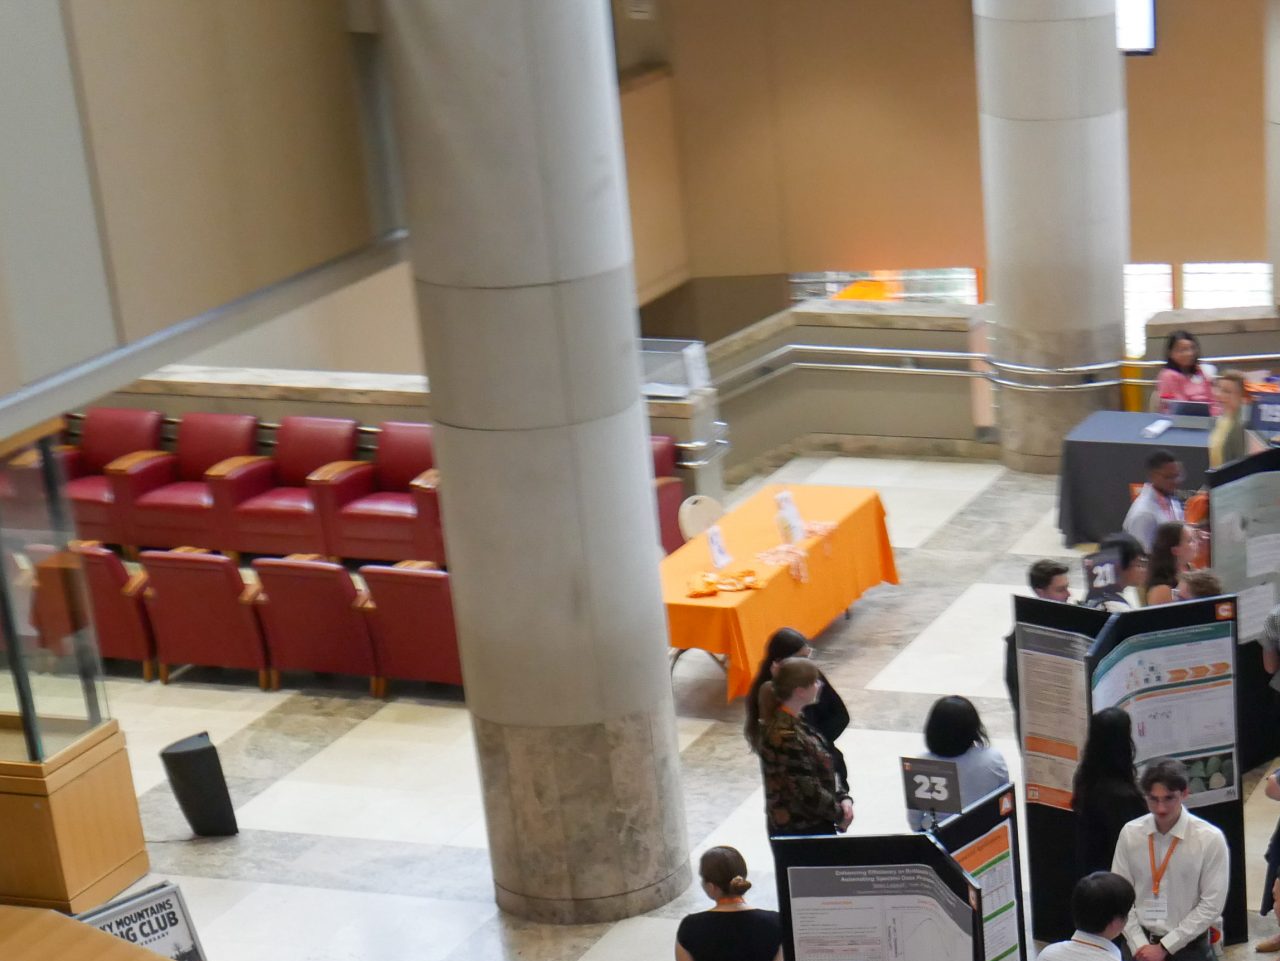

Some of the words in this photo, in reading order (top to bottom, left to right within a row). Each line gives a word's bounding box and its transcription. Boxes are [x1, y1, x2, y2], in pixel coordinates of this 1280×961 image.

[1092, 563, 1115, 587] 21
[913, 774, 949, 801] 23
[115, 899, 173, 930] MOUNTAINS
[139, 911, 178, 938] CLUB
